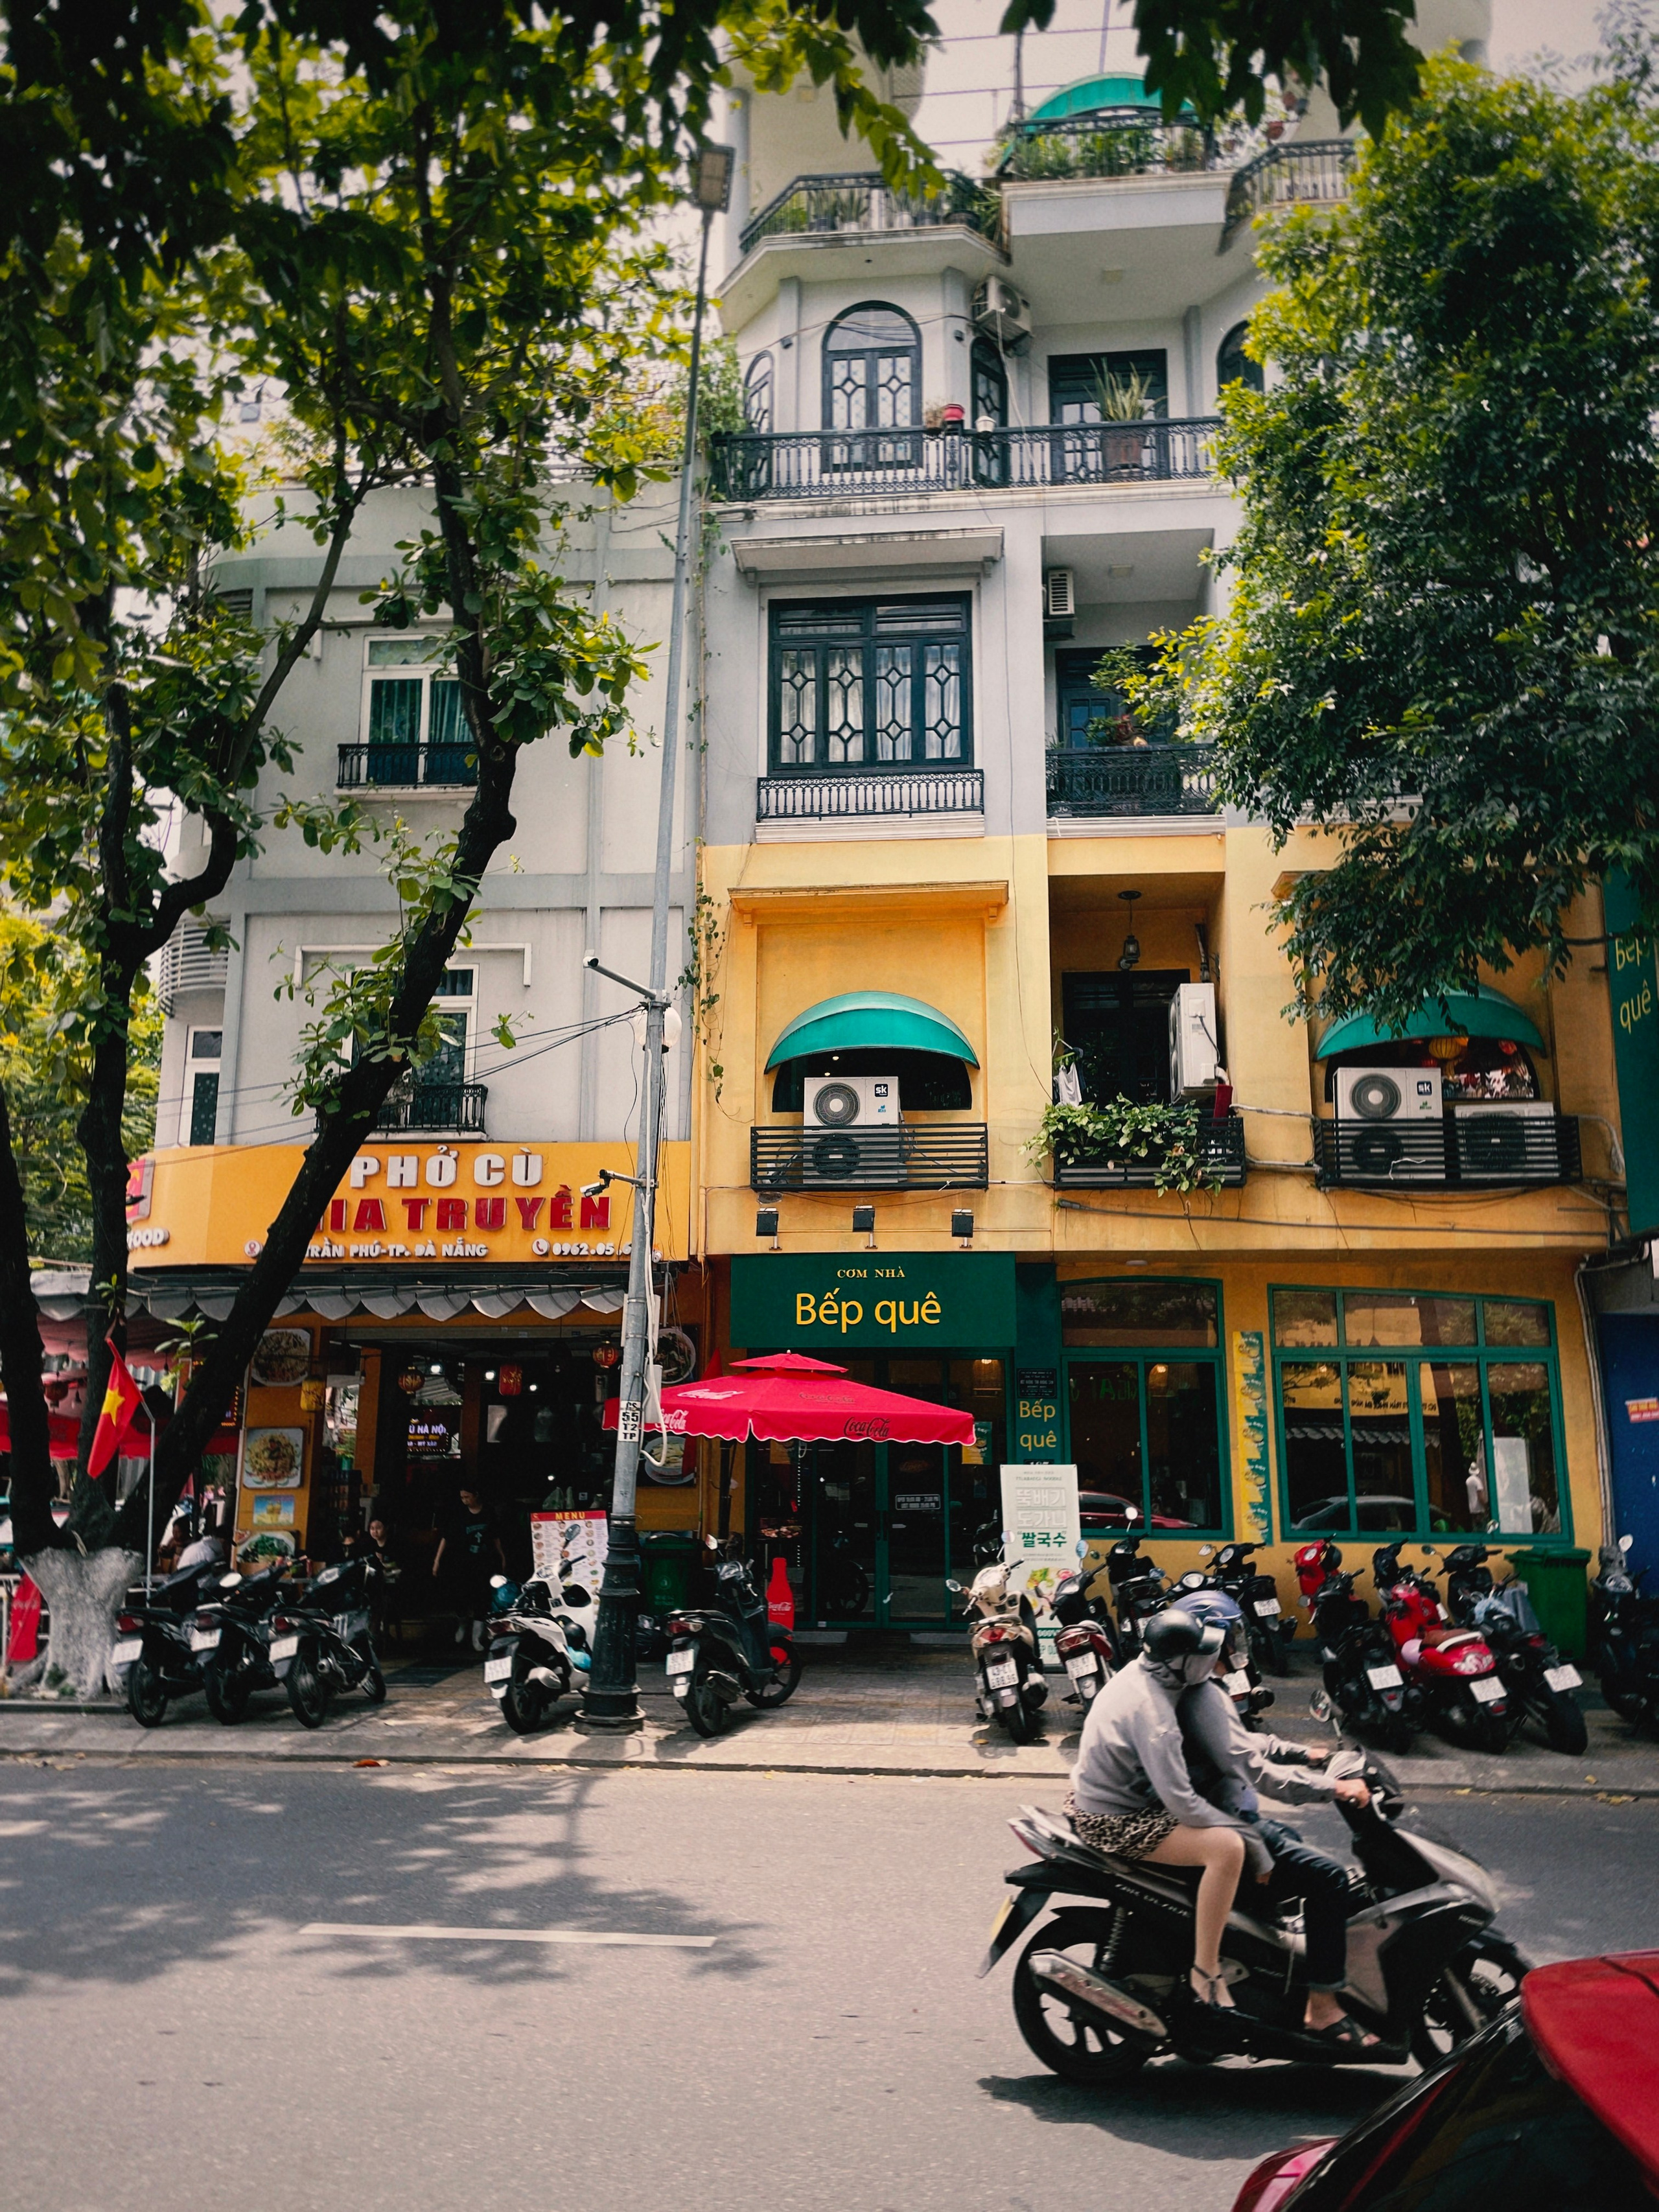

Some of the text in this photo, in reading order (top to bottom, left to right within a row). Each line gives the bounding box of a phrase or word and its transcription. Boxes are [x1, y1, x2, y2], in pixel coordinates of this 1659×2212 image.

[1620, 979, 1651, 1034] quê
[350, 1145, 543, 1187] PHỞ CÙ
[318, 1184, 612, 1231] IA TRUYỀN
[837, 1266, 906, 1278] CƠM NHÀ
[796, 1288, 941, 1333] Bếp quê
[622, 1412, 638, 1422] 55
[1019, 1399, 1056, 1422] Bếp
[1019, 1430, 1057, 1452] quê
[1016, 1488, 1066, 1508] 뚝배기
[555, 1511, 585, 1520] MENU
[1017, 1509, 1067, 1528] 도가니
